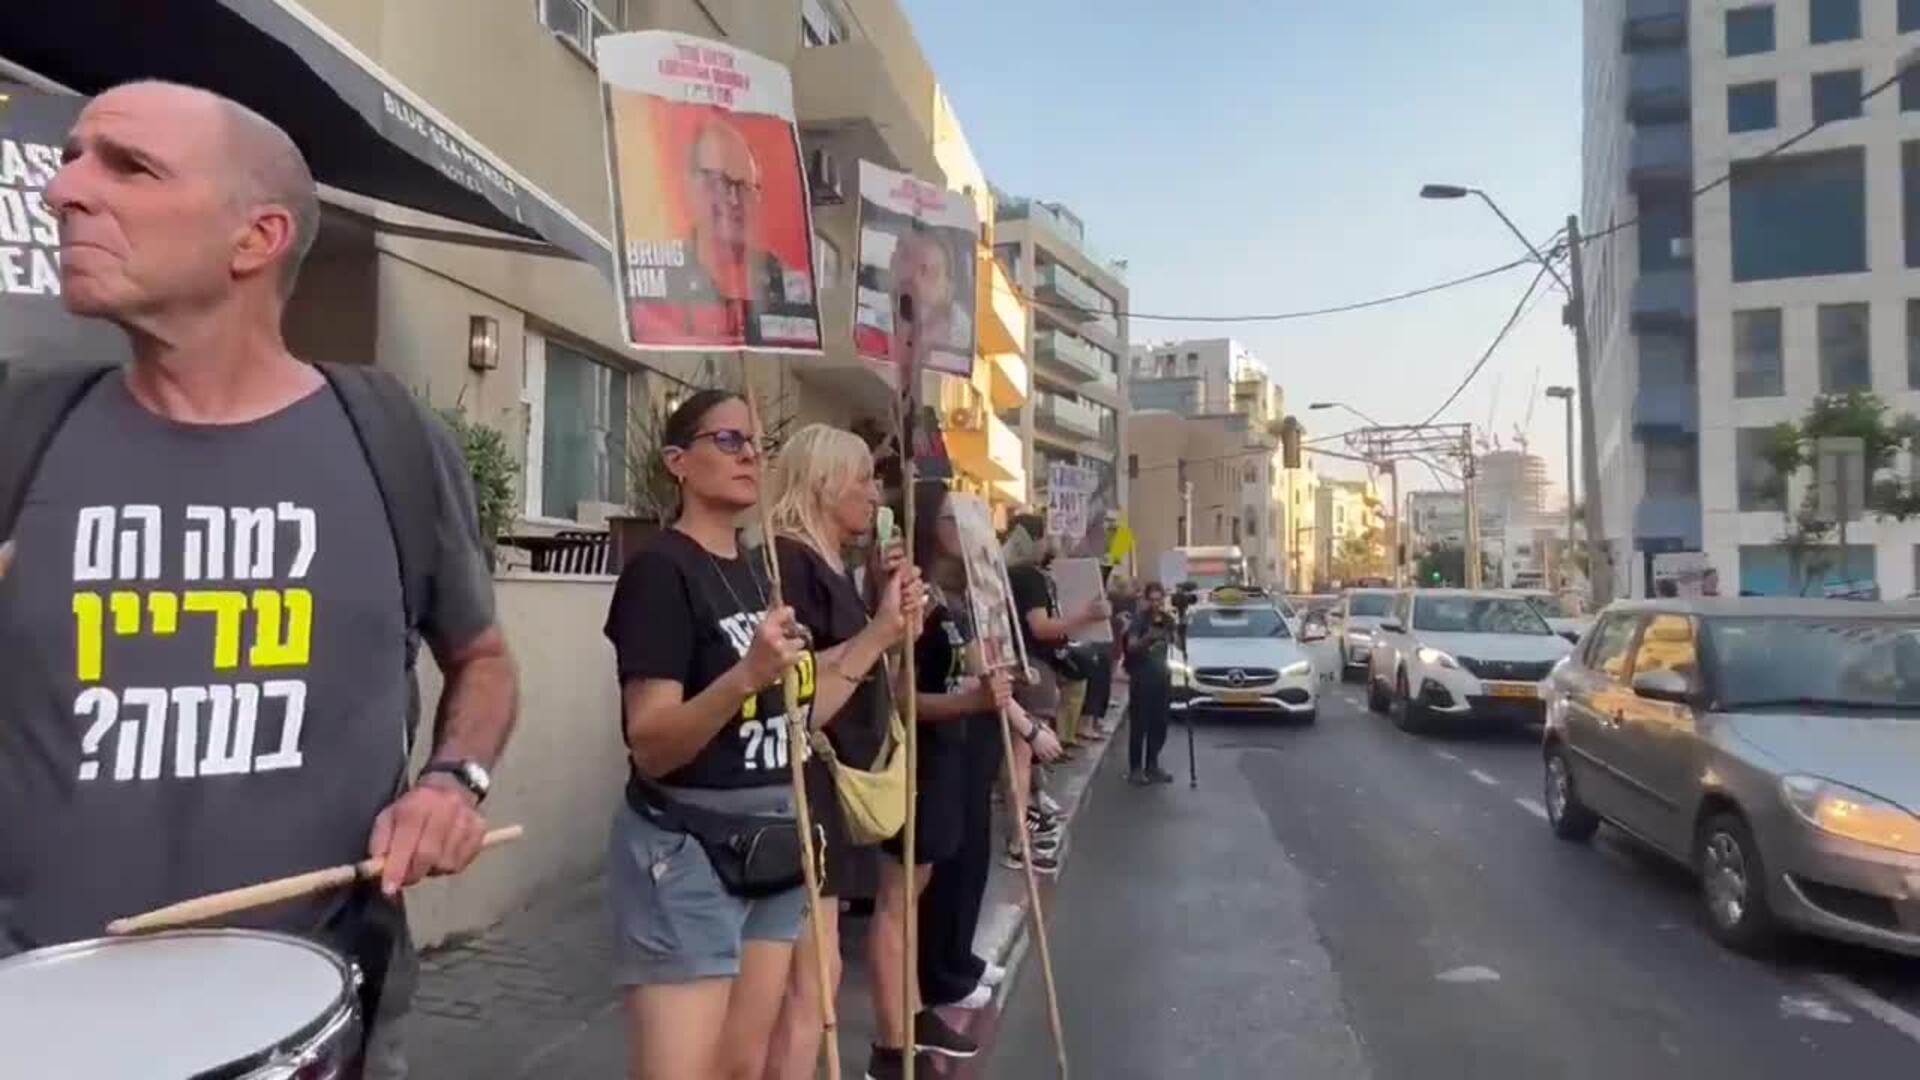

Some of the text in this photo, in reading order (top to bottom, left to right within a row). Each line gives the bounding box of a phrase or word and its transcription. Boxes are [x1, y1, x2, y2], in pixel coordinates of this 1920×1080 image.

[383, 91, 428, 137] BLUE
[430, 126, 461, 159] SEA
[0, 139, 63, 188] AS
[0, 246, 61, 295] EA
[626, 240, 684, 267] BRING
[628, 268, 667, 298] HIM
[73, 502, 316, 581] למה הם
[72, 589, 313, 681] עדיין
[73, 680, 306, 781] בעזה?
